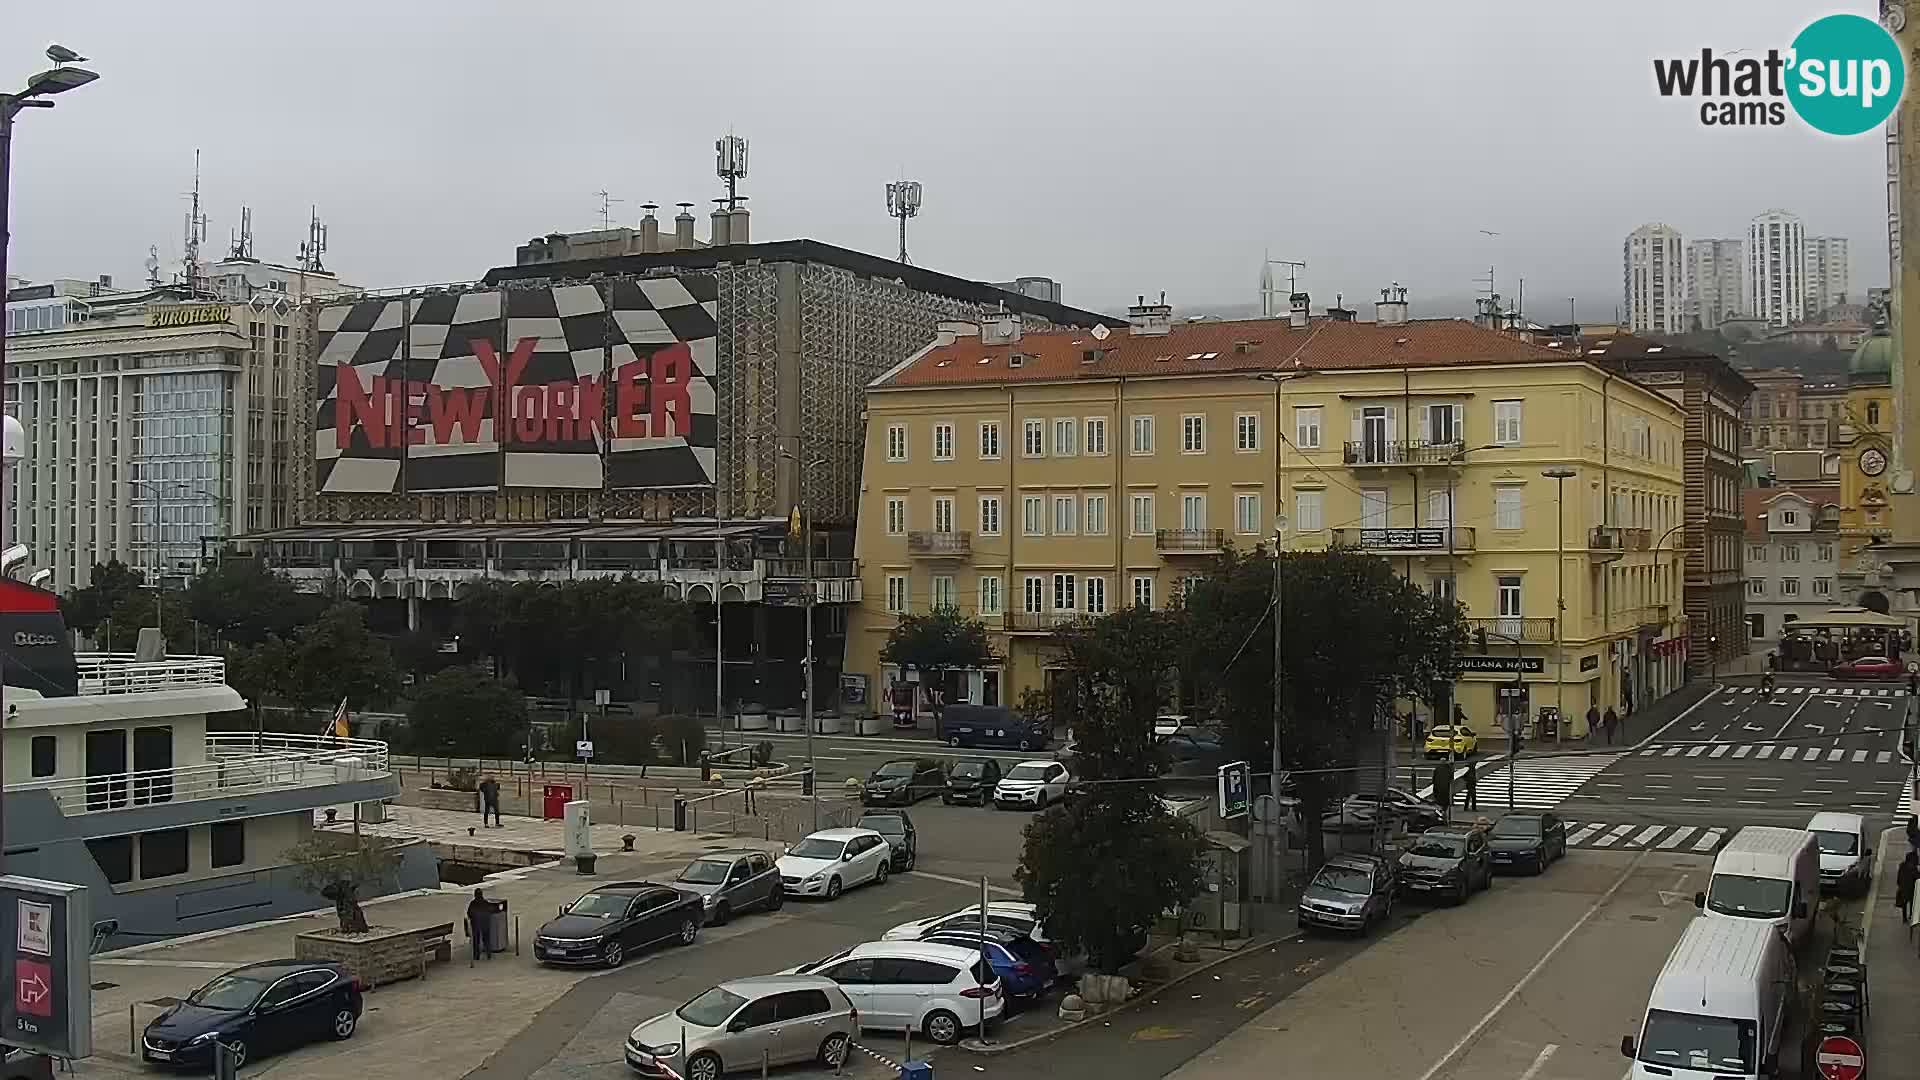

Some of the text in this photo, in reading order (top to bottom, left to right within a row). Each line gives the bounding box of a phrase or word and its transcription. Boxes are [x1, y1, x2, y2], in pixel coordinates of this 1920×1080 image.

[1456, 660, 1538, 670] JULIANA NAILS
[17, 1018, 38, 1033] 5 km
